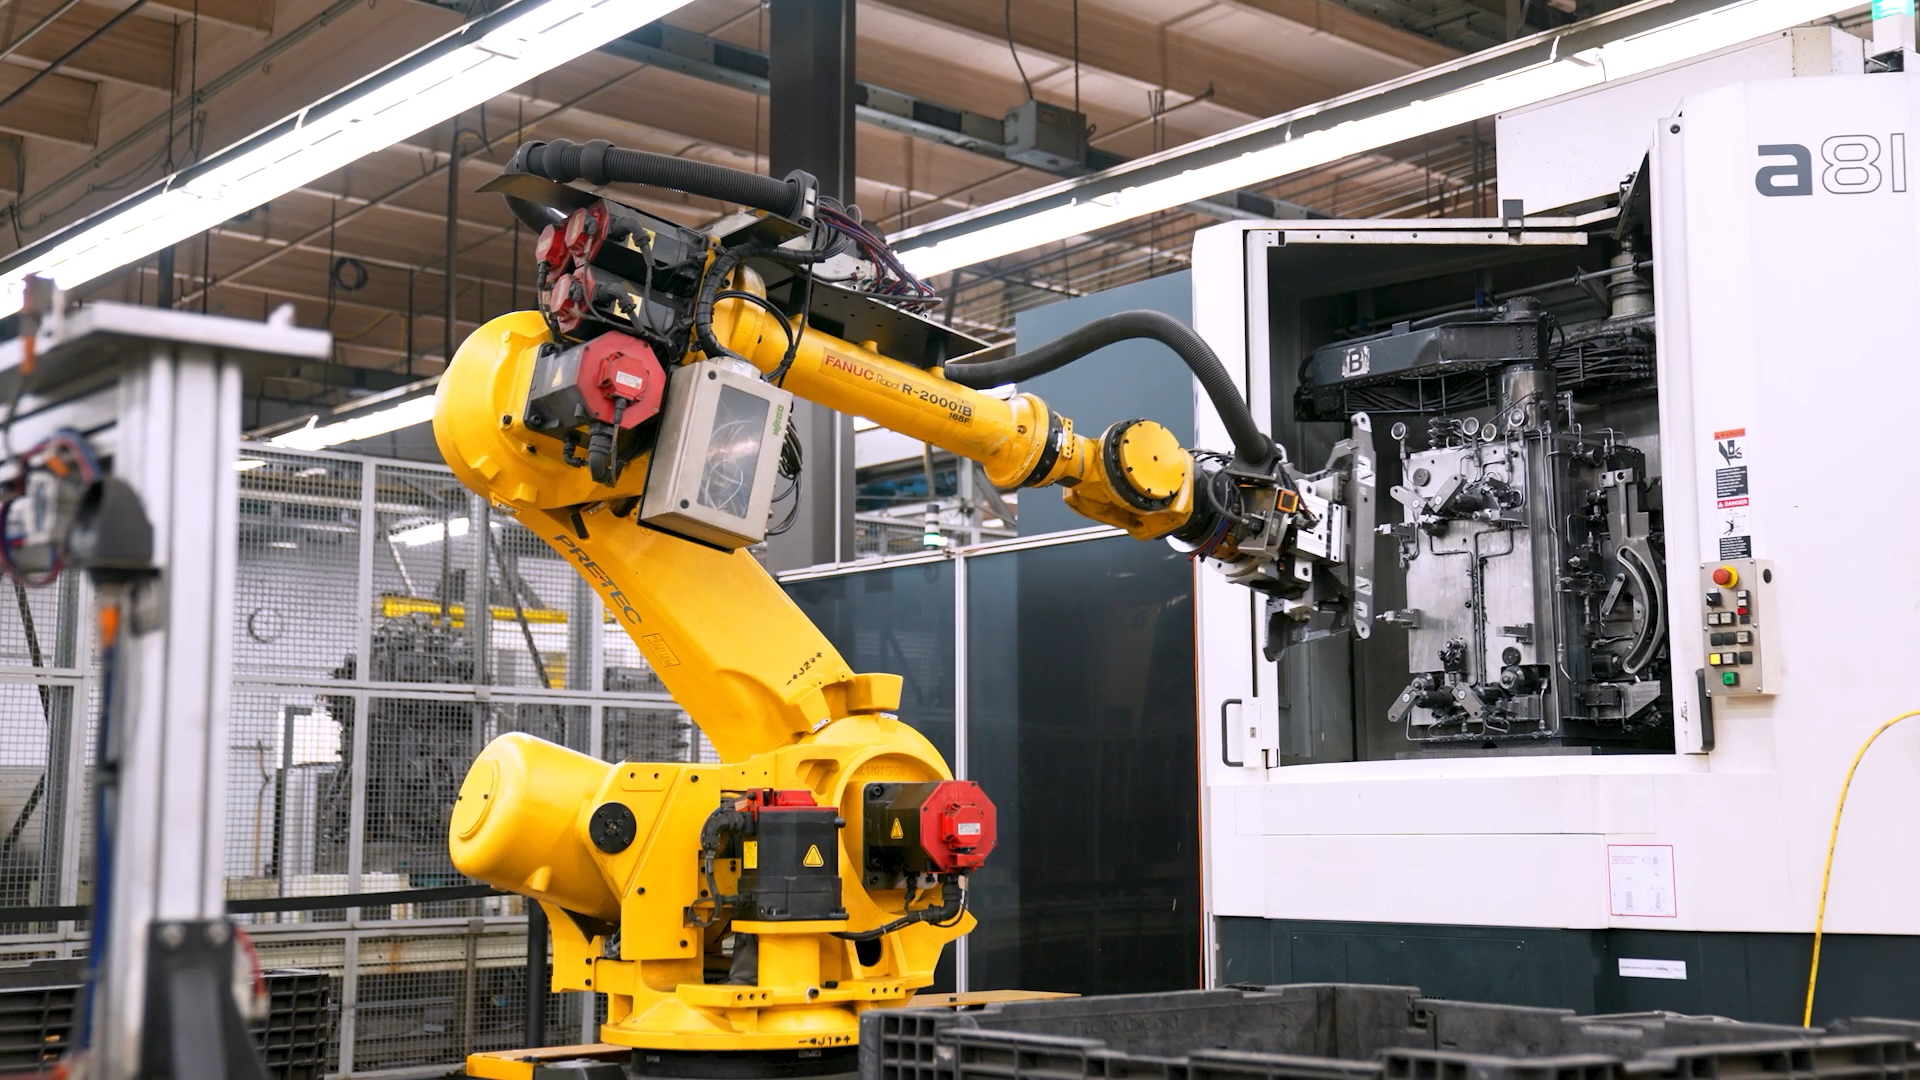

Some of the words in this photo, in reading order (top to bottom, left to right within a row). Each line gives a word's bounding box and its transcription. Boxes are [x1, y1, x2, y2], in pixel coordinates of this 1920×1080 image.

[1350, 351, 1363, 373] B
[825, 355, 874, 381] FANUC
[876, 374, 900, 391] Robot
[902, 382, 973, 417] R-2000iB
[772, 404, 784, 437] WAGO
[949, 412, 971, 424] 165F
[554, 534, 642, 625] PRETEC
